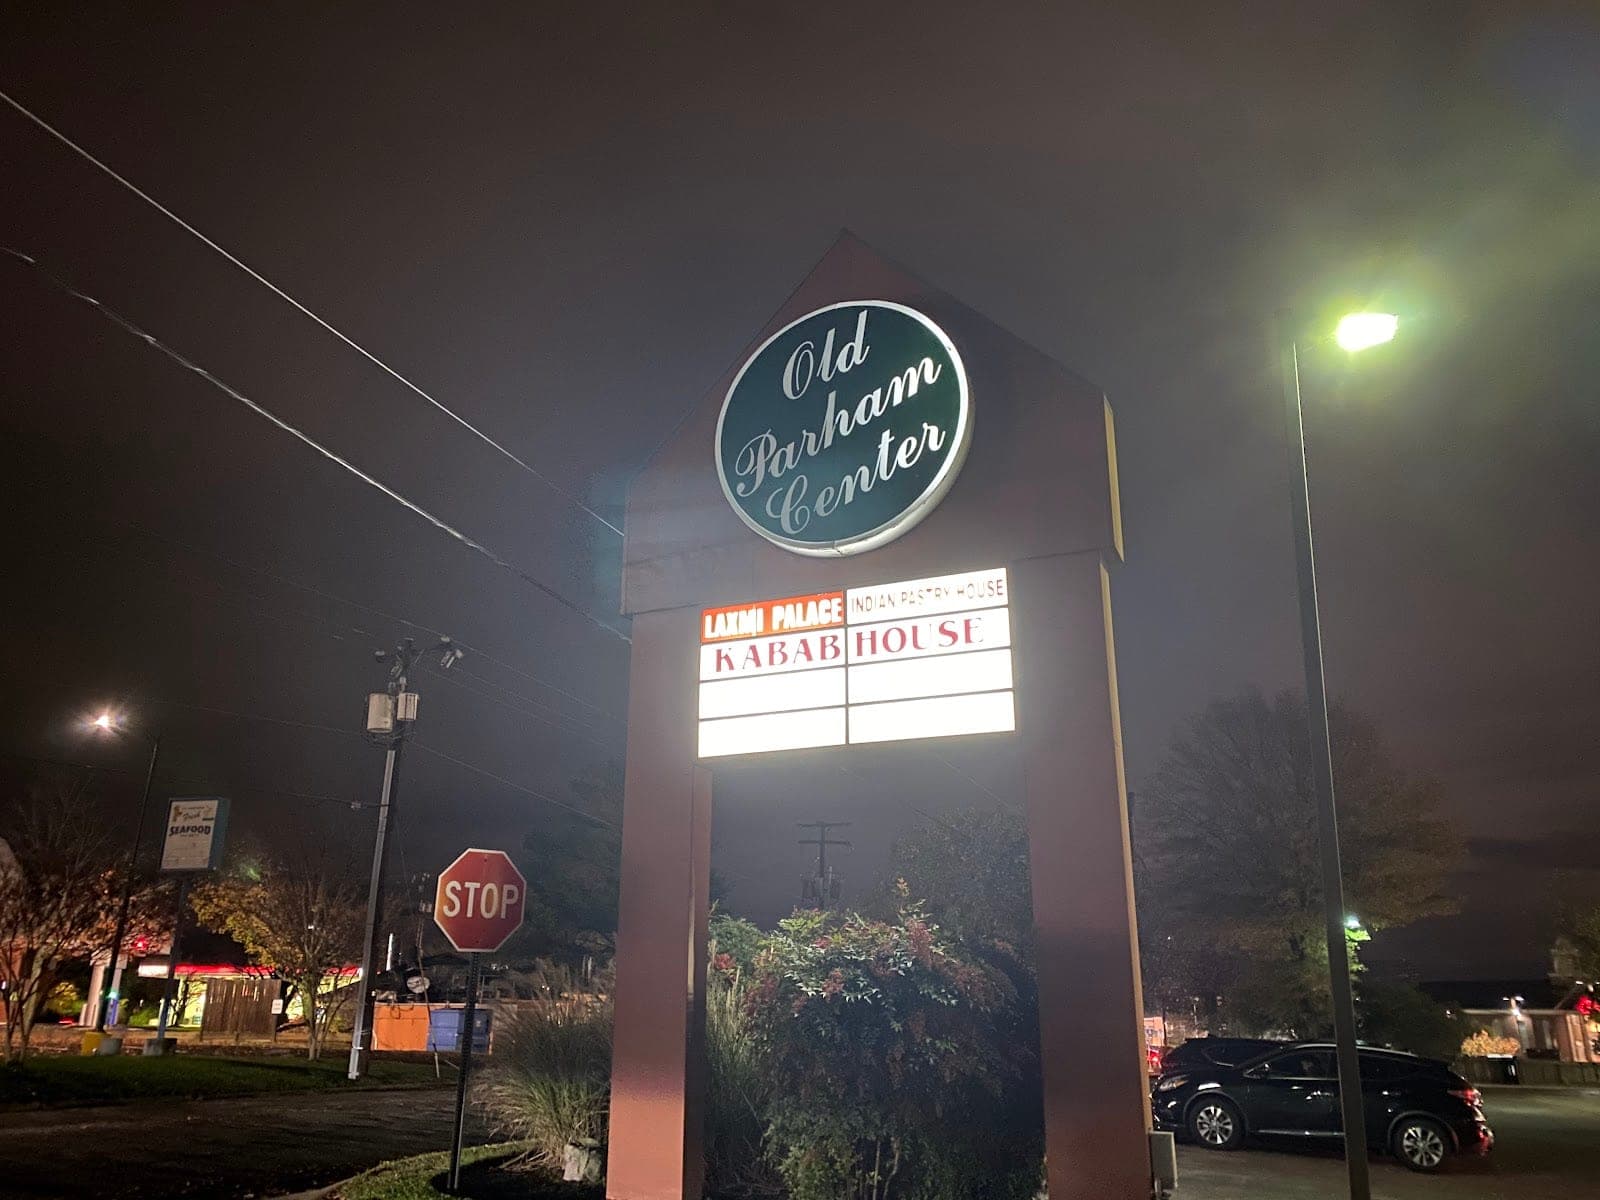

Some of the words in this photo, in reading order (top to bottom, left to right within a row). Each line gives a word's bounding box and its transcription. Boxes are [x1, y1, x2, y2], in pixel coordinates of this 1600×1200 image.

[782, 309, 870, 400] Old
[735, 356, 942, 498] Parham
[765, 421, 946, 535] Center
[771, 598, 842, 632] PALACE
[852, 591, 895, 612] INDIAN
[957, 579, 1004, 599] HOUSE
[704, 605, 764, 639] LAXMI
[715, 634, 841, 673] KABAB
[856, 617, 984, 656] HOUSE
[168, 825, 211, 837] SEAFOOD
[442, 880, 519, 920] STOP
